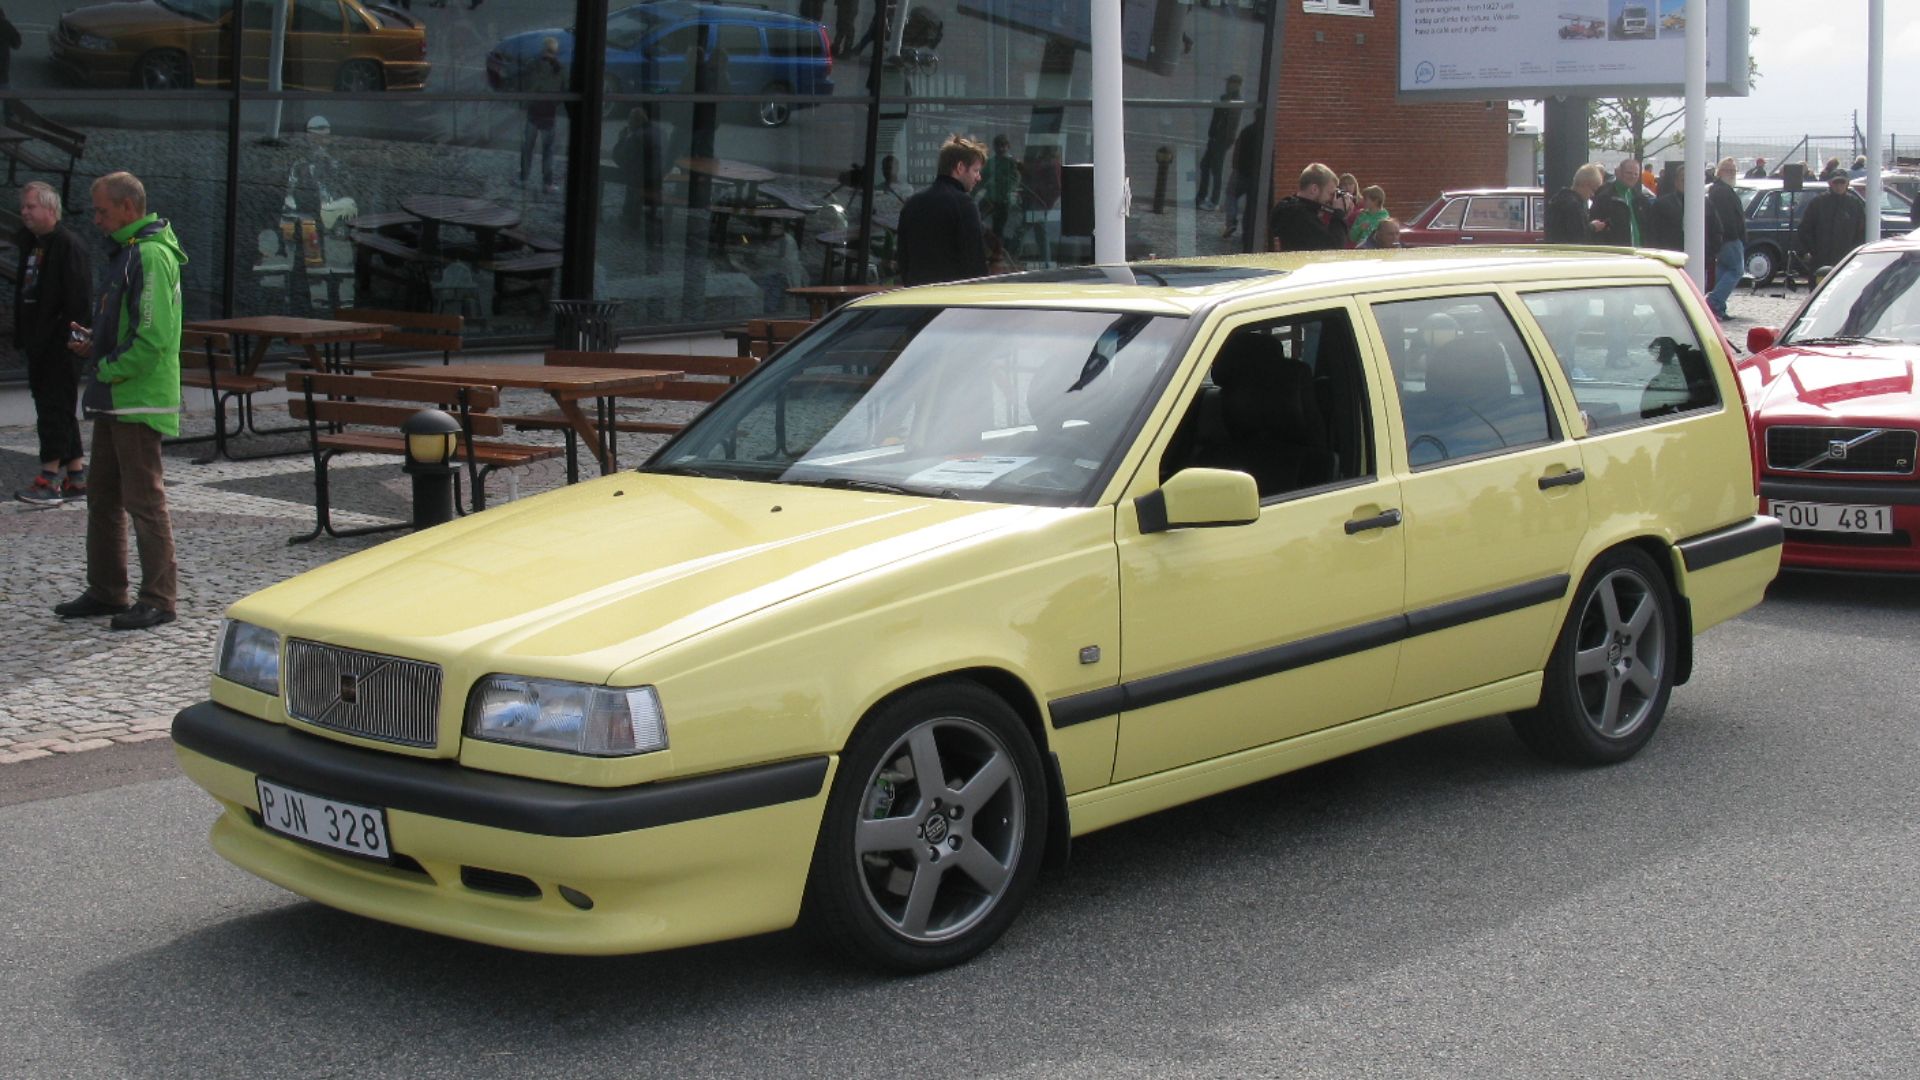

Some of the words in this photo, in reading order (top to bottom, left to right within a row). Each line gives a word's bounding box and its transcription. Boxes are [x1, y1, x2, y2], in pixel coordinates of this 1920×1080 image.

[1482, 3, 1500, 11] 1927
[1414, 16, 1433, 25] today
[1433, 15, 1446, 24] and
[1460, 14, 1471, 22] the
[1492, 12, 1505, 21] We
[1414, 27, 1431, 35] have
[1838, 508, 1883, 531] 481
[262, 786, 308, 834] PJN
[324, 804, 380, 850] 328
